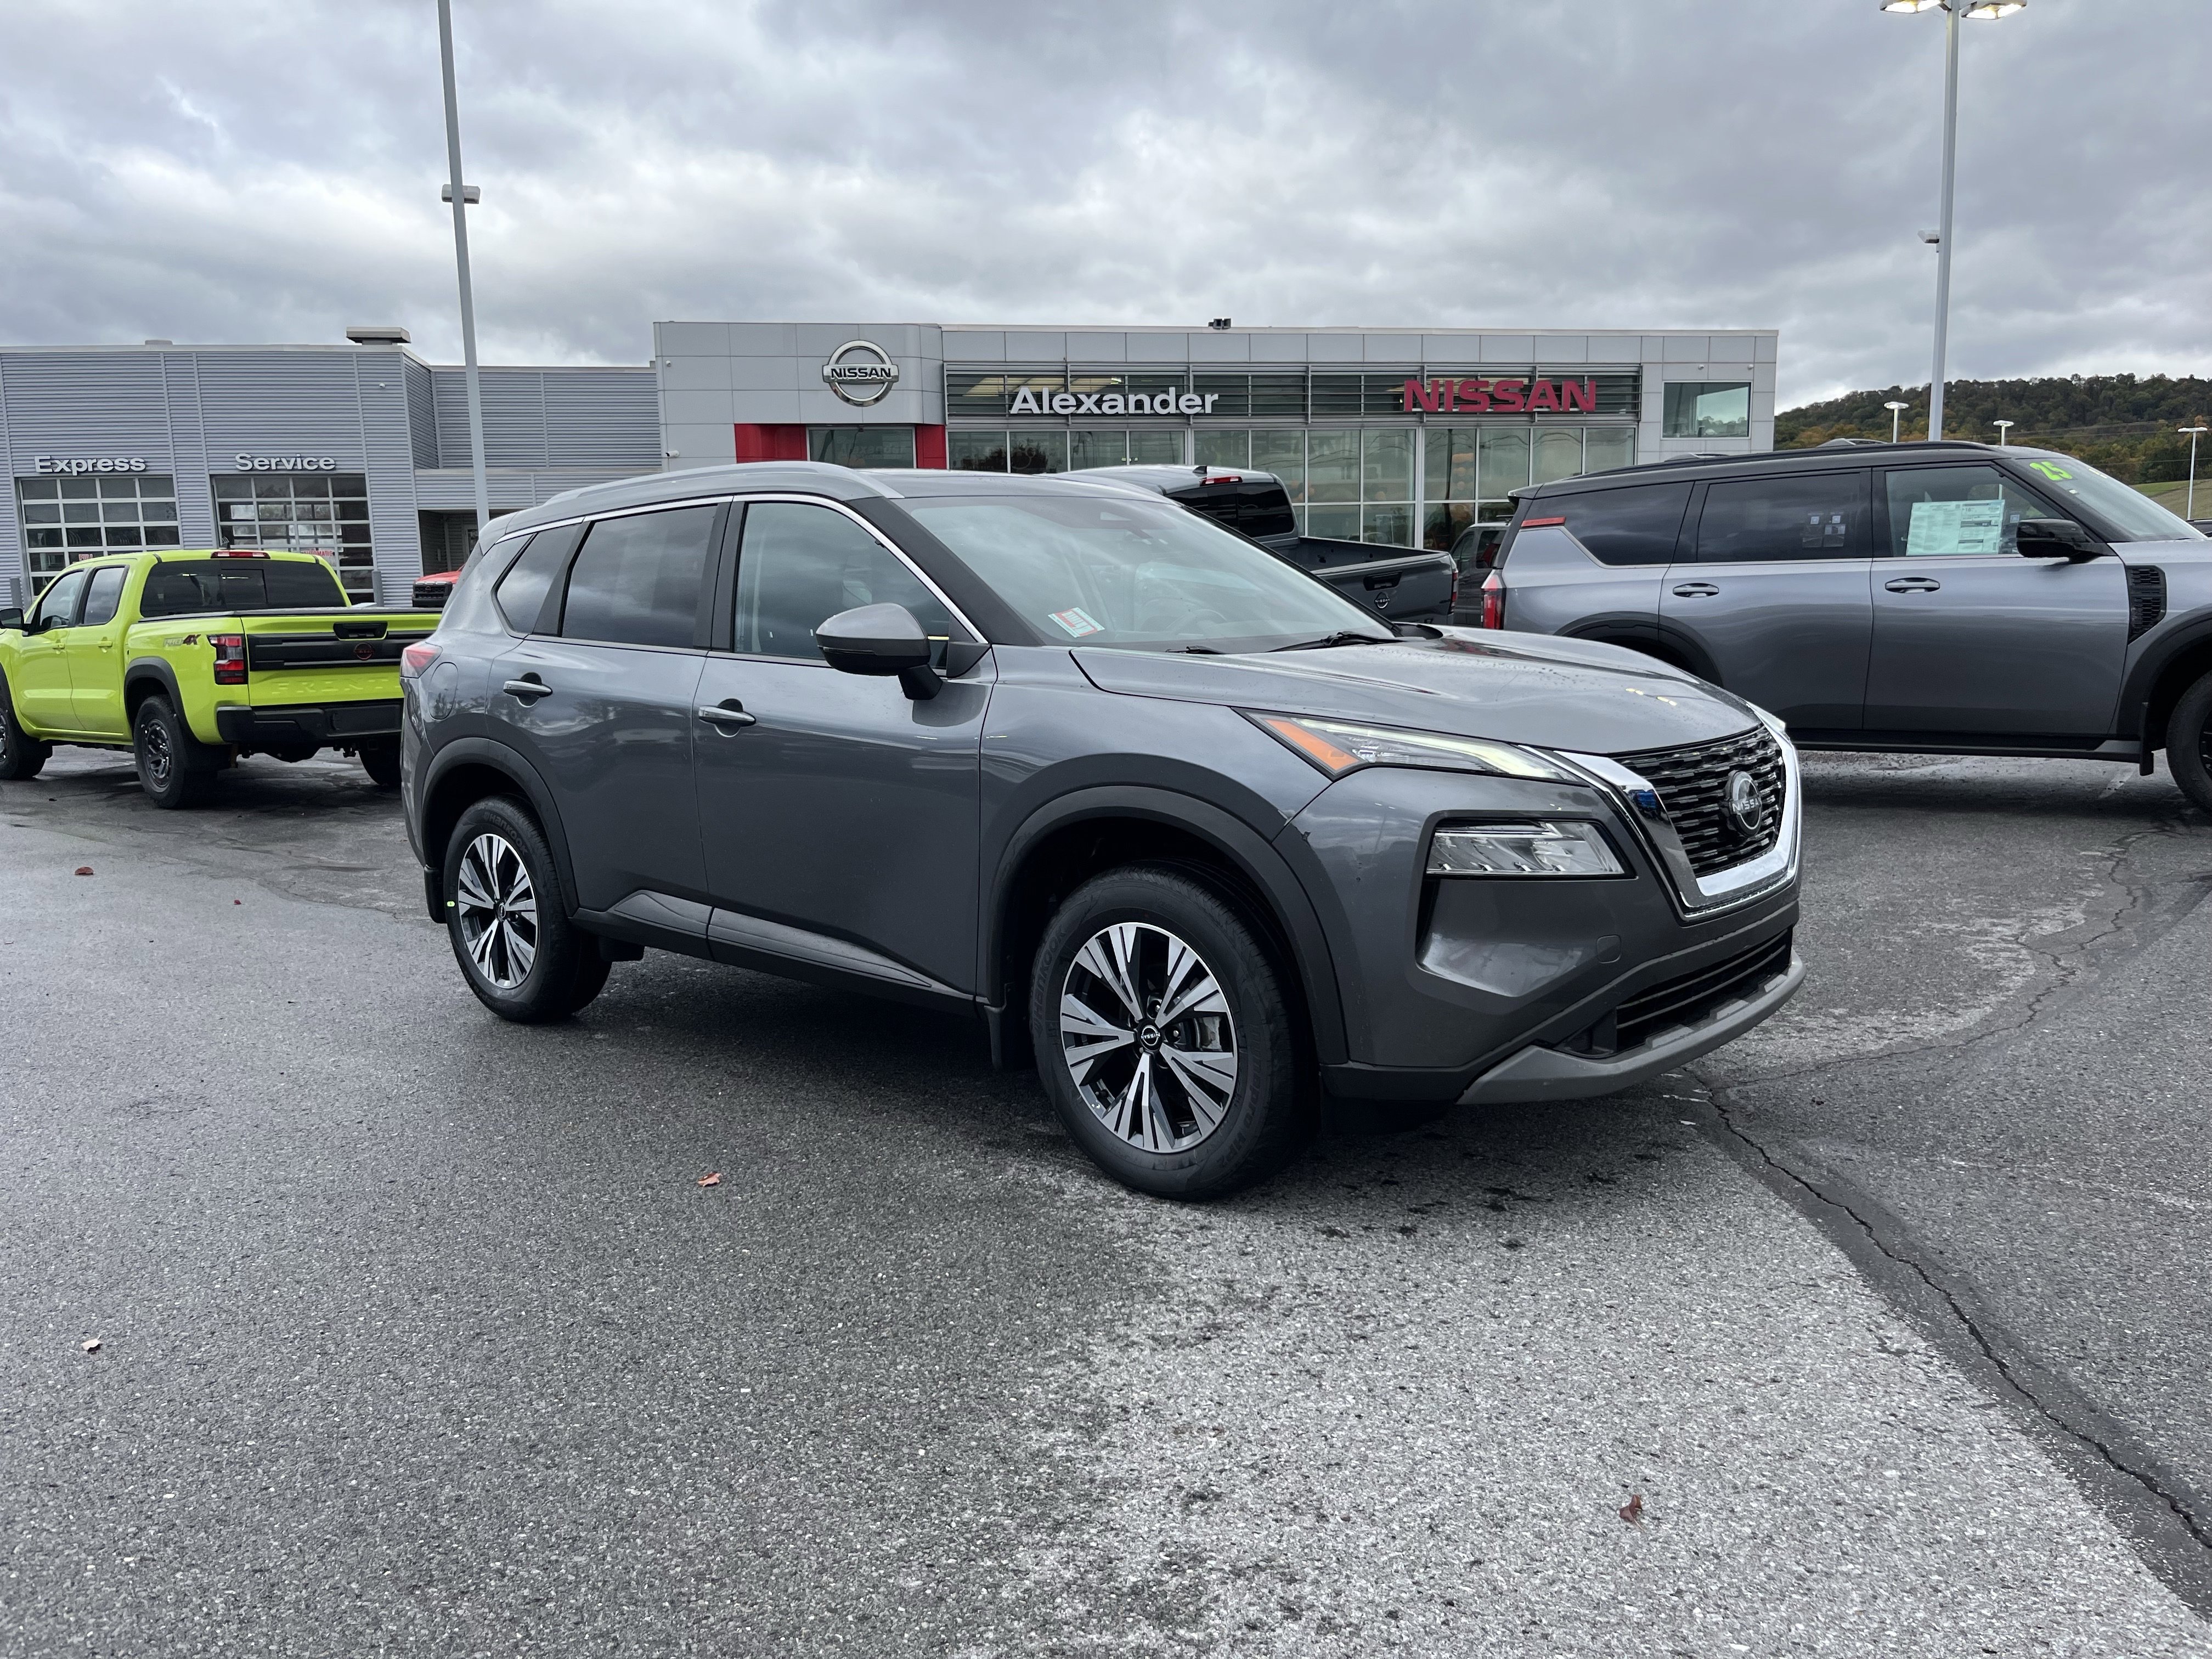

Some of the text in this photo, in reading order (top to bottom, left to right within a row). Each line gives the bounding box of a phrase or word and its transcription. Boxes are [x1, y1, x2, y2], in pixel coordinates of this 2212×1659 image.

[831, 367, 892, 379] NISSAN
[1009, 386, 1219, 415] Alexander
[1403, 380, 1596, 412] NISSAN
[34, 455, 146, 476] Express
[235, 453, 336, 471] Service
[2029, 461, 2073, 481] 25
